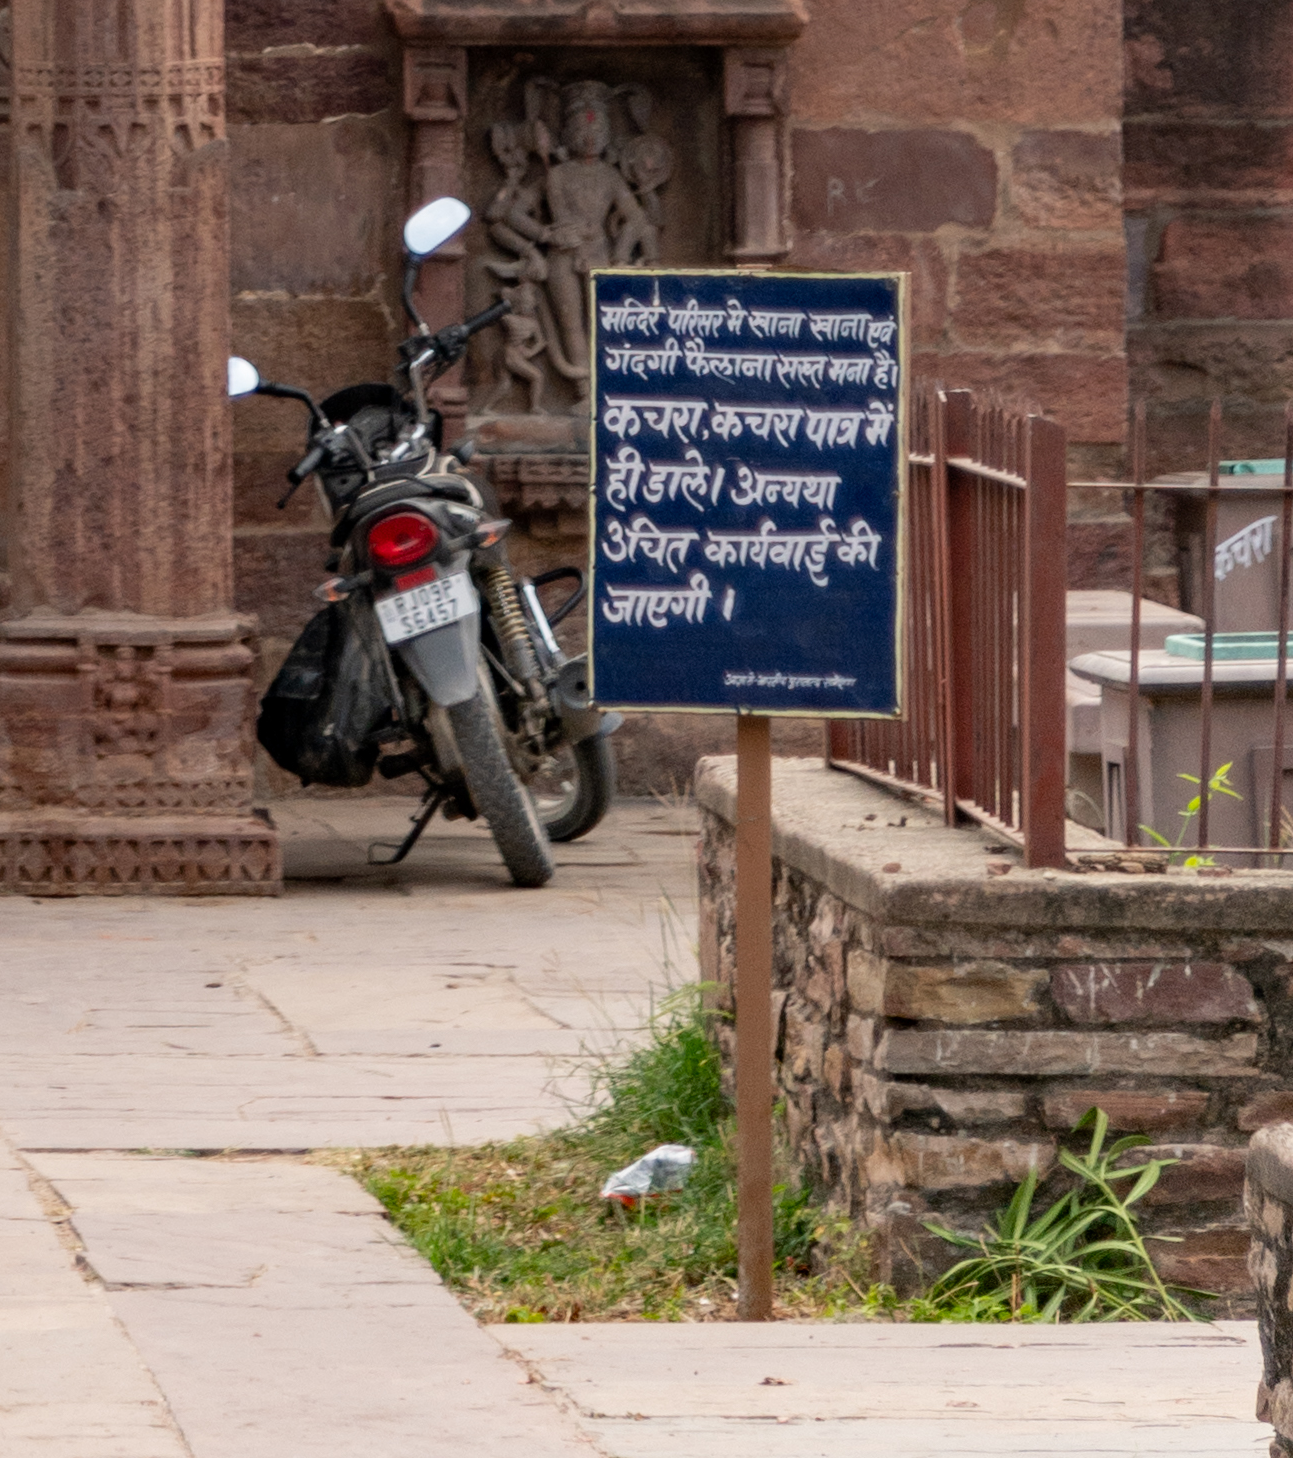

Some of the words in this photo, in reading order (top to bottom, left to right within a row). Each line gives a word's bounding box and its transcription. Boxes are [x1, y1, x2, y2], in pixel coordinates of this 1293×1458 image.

[667, 299, 726, 338] परिसर
[749, 310, 806, 338] खाना
[807, 312, 873, 341] खाना
[868, 316, 897, 348] एवं
[605, 338, 683, 380] गंदगी
[683, 338, 779, 384] फैलाना
[775, 354, 829, 388] सख्त
[828, 356, 873, 385] मना
[712, 402, 803, 447] कचरा
[805, 406, 865, 450] पात्र
[865, 402, 894, 447] में
[606, 446, 645, 511] ही
[731, 466, 842, 510] अन्यथा
[603, 516, 699, 573] उचित
[837, 520, 881, 570] की
[603, 573, 712, 627] जाएगी
